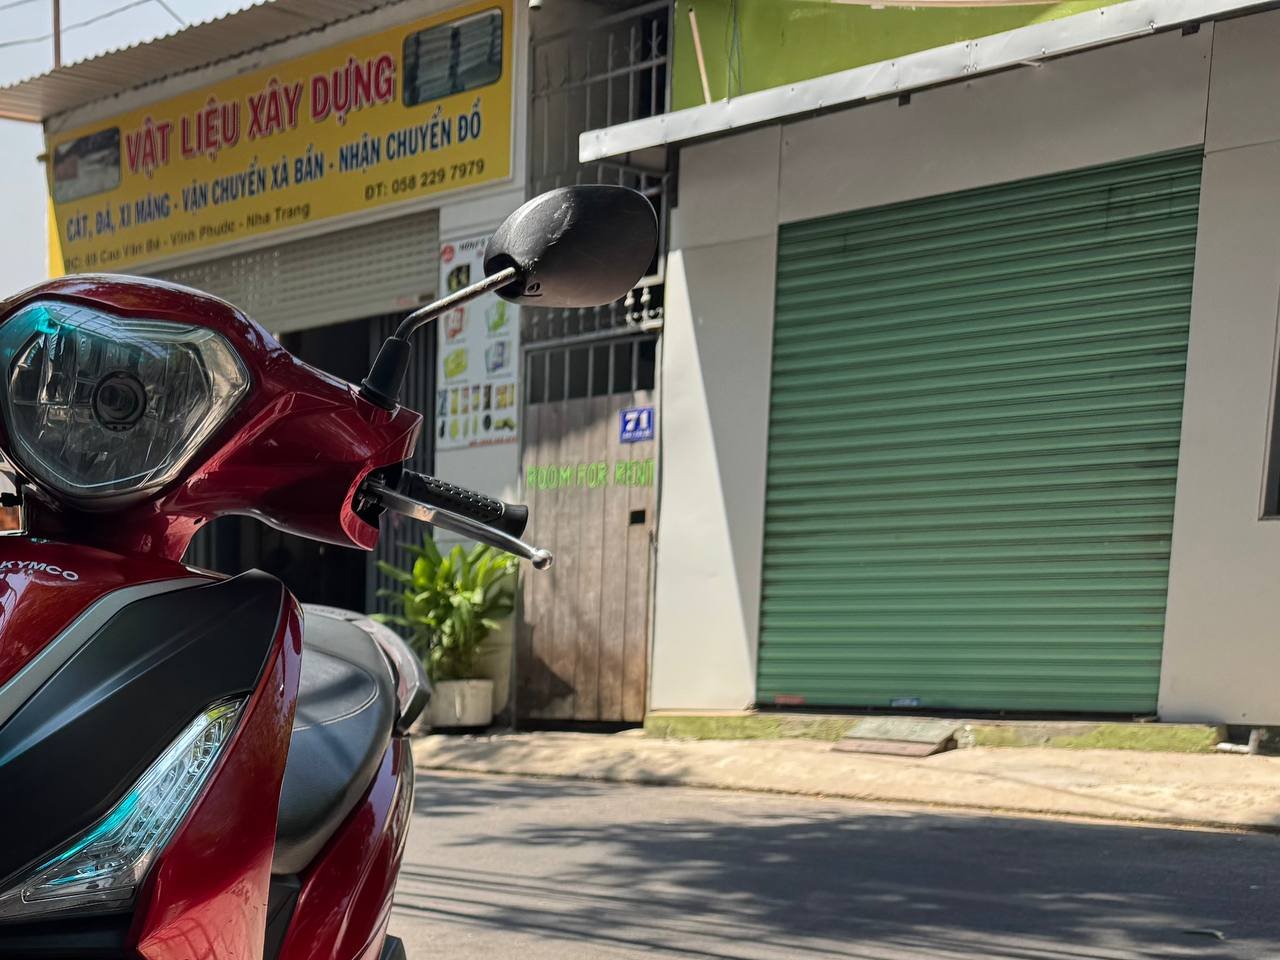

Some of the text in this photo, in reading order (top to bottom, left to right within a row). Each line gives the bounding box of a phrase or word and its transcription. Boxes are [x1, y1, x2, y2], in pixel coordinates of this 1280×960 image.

[125, 54, 396, 180] VẬT LIỆU XÂY DỰNG
[119, 202, 132, 227] XI
[182, 179, 208, 216] VẬN
[211, 155, 267, 206] CHUYỂN
[339, 132, 381, 174] NHẬN
[386, 104, 452, 160] CHUYỂN
[364, 159, 485, 201] ĐT: 058 229 7979
[246, 213, 271, 228] Nha
[275, 203, 311, 220] Trang
[624, 410, 649, 432] 71
[527, 458, 655, 490] ROOM FOR RENT
[0, 560, 79, 582] KYMCO
